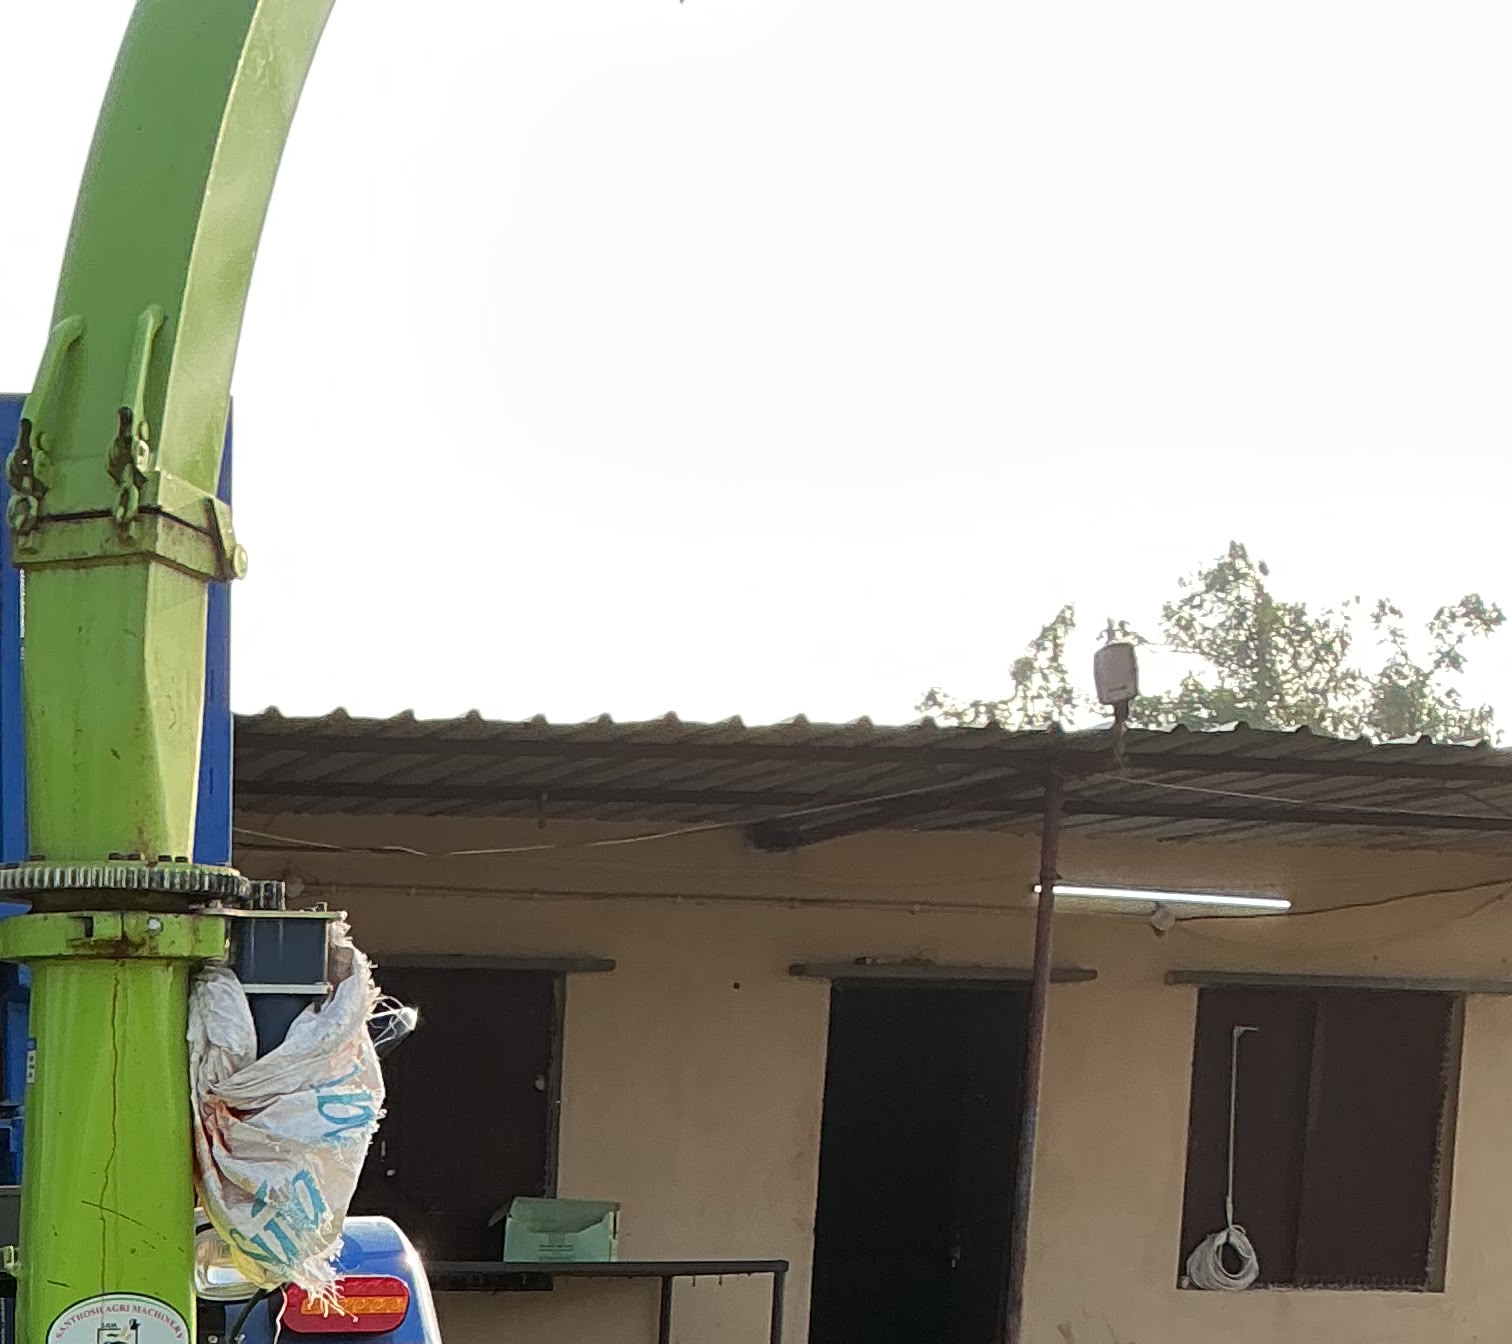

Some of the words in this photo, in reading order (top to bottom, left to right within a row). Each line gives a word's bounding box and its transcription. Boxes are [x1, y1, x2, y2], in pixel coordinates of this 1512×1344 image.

[55, 1306, 104, 1339] SANTHOSH
[105, 1303, 130, 1313] AGRI
[133, 1304, 183, 1339] MACHINERY
